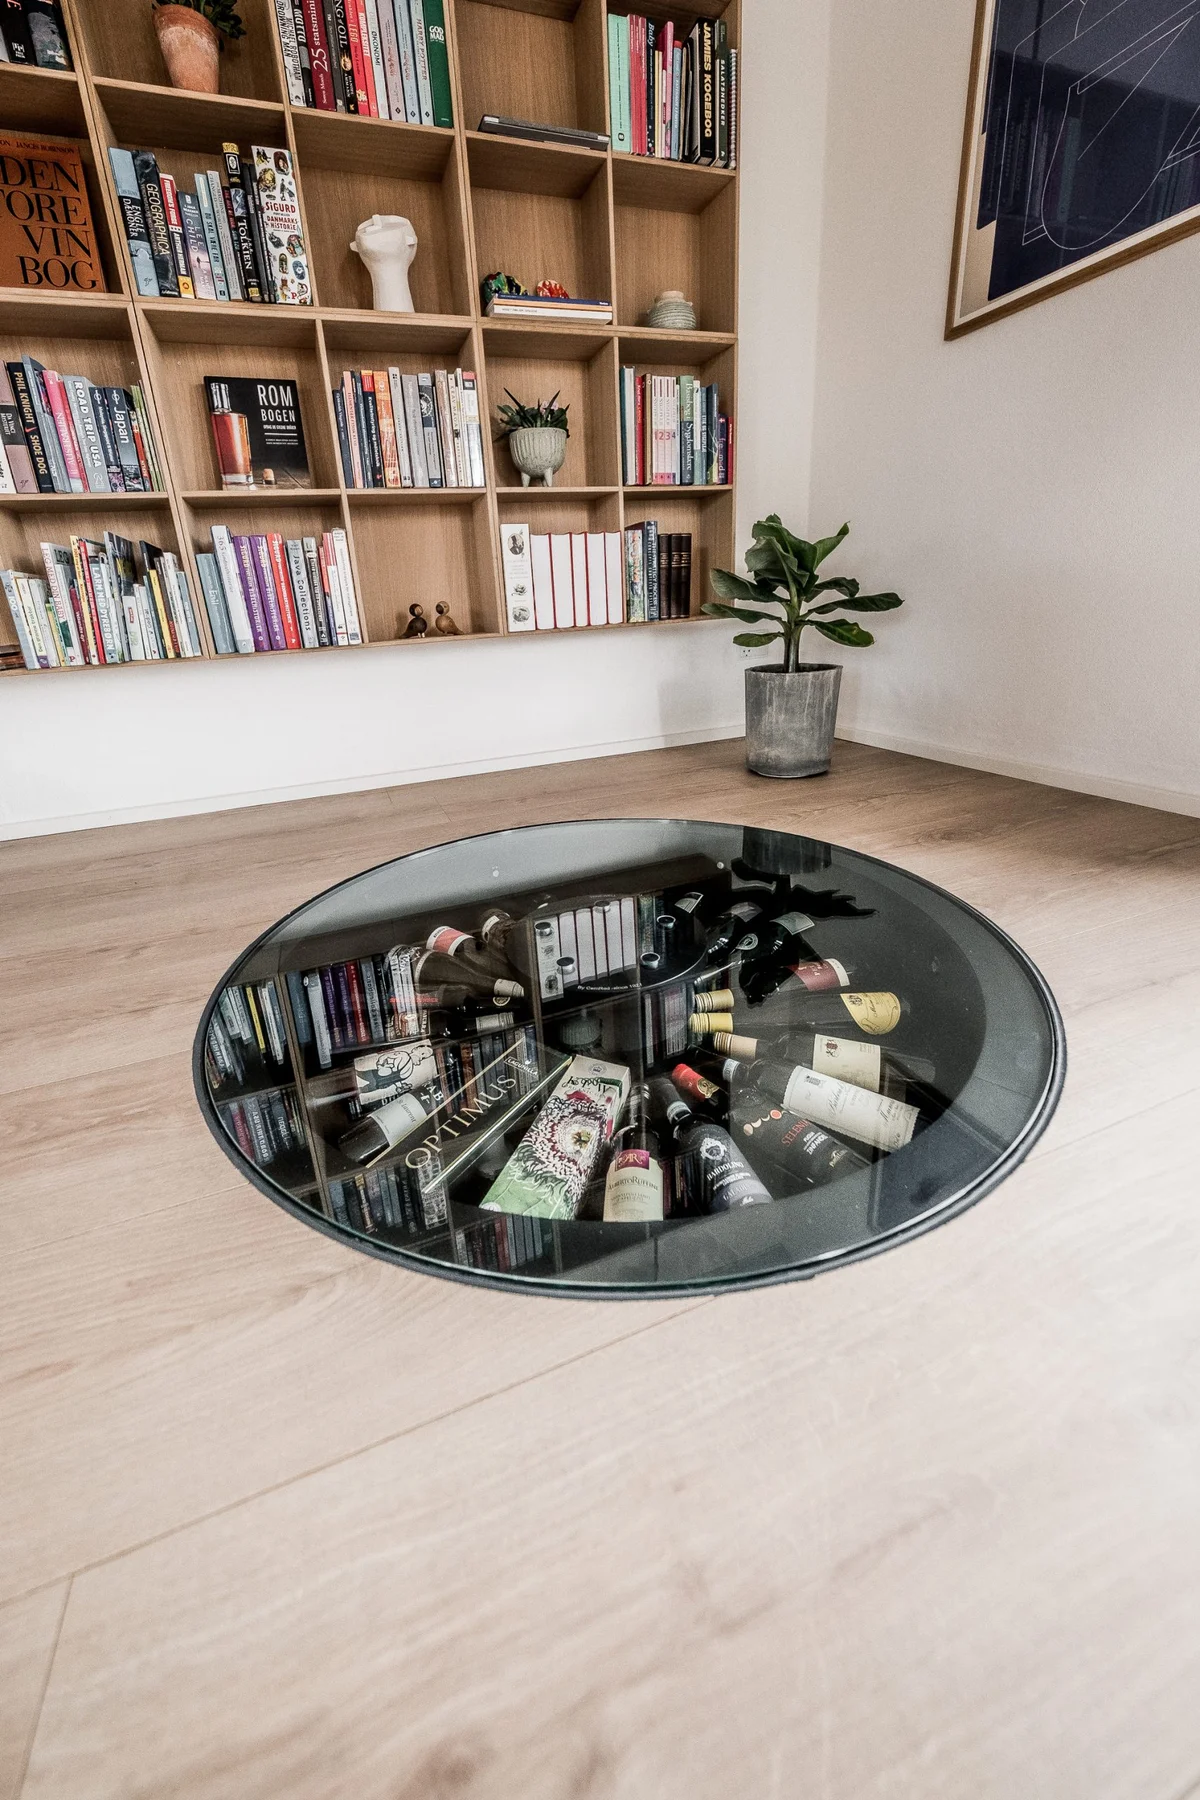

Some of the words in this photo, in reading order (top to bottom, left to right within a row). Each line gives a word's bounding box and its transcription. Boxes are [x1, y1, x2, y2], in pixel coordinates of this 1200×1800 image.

[337, 25, 348, 48] OIL
[349, 23, 358, 43] LEGO
[359, 12, 370, 58] KOMPLEKSITET
[311, 47, 328, 74] 25
[0, 156, 80, 193] DEN
[0, 188, 88, 226] ORE
[132, 204, 145, 233] ENGLE
[146, 182, 170, 256] GEOGRAPHICA
[19, 224, 92, 258] VIN
[186, 218, 198, 253] CHILD
[195, 226, 204, 247] LEE
[237, 219, 254, 271] TOLKIEN
[16, 255, 98, 290] BOG
[14, 371, 25, 390] PHIL
[20, 392, 34, 424] KNIGHT
[257, 384, 294, 407] ROM
[74, 380, 89, 414] ROAD
[83, 417, 95, 442] TRIP
[90, 445, 101, 468] USA
[112, 405, 131, 444] Japan
[260, 408, 296, 422] BOGEN
[659, 432, 664, 440] 2
[665, 432, 670, 440] 3
[684, 423, 692, 470] Sygdomslære
[30, 434, 42, 456] SHOE
[36, 456, 47, 475] DOG
[217, 535, 226, 551] 365
[42, 548, 51, 565] LEG
[47, 567, 56, 584] MED
[55, 600, 65, 621] BABY
[293, 554, 302, 576] Java
[298, 579, 312, 631] Collections
[100, 609, 115, 650] DYREBØRN
[405, 1074, 517, 1169] OPTIMUS
[706, 1161, 744, 1180] BARDOLINO
